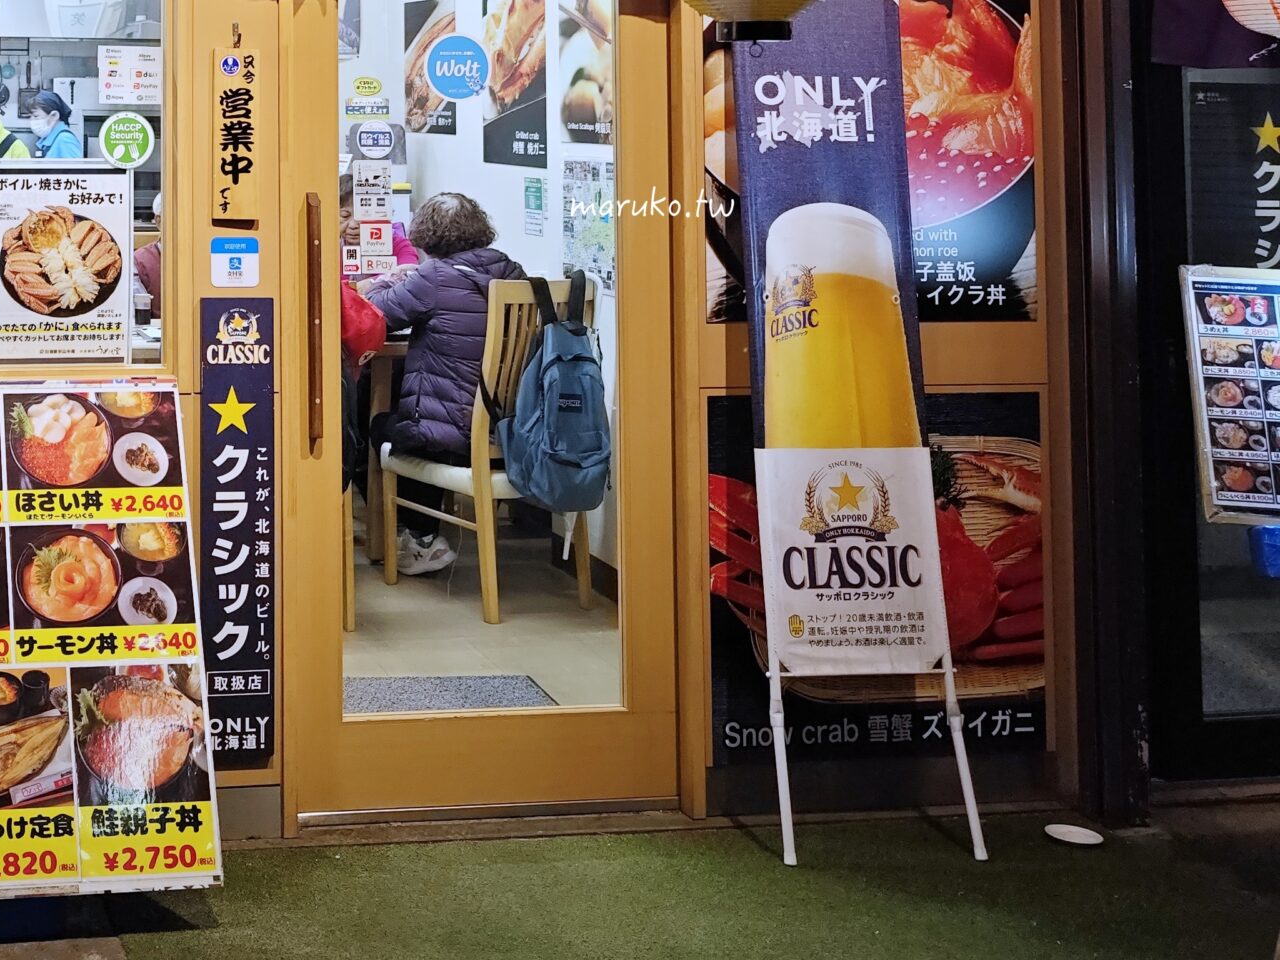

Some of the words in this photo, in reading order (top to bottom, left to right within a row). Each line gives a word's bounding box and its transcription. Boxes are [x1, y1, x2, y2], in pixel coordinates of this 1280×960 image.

[436, 59, 481, 78] Wolt
[109, 131, 144, 141] Security
[111, 123, 143, 132] HACCP
[219, 87, 255, 185] 営業中
[928, 229, 957, 241] with
[938, 247, 959, 257] roe
[376, 260, 394, 270] Pay
[770, 308, 820, 338] CLASSIC
[206, 344, 270, 365] CLASSIC
[828, 459, 848, 470] SINCE
[15, 490, 104, 513] ほさい丼
[110, 494, 184, 515] ¥2,640
[831, 514, 868, 523] SAPPORO
[210, 444, 250, 662] クラシック
[782, 544, 923, 590] CLASSIC
[16, 632, 118, 657] サーモン丼
[213, 675, 263, 691] 取扱店
[801, 717, 859, 745] crab
[867, 714, 913, 743] 雪蟹
[921, 710, 1035, 740] ズイガニ
[91, 803, 203, 838] 鮭親子丼
[103, 845, 197, 873] ¥2,750
